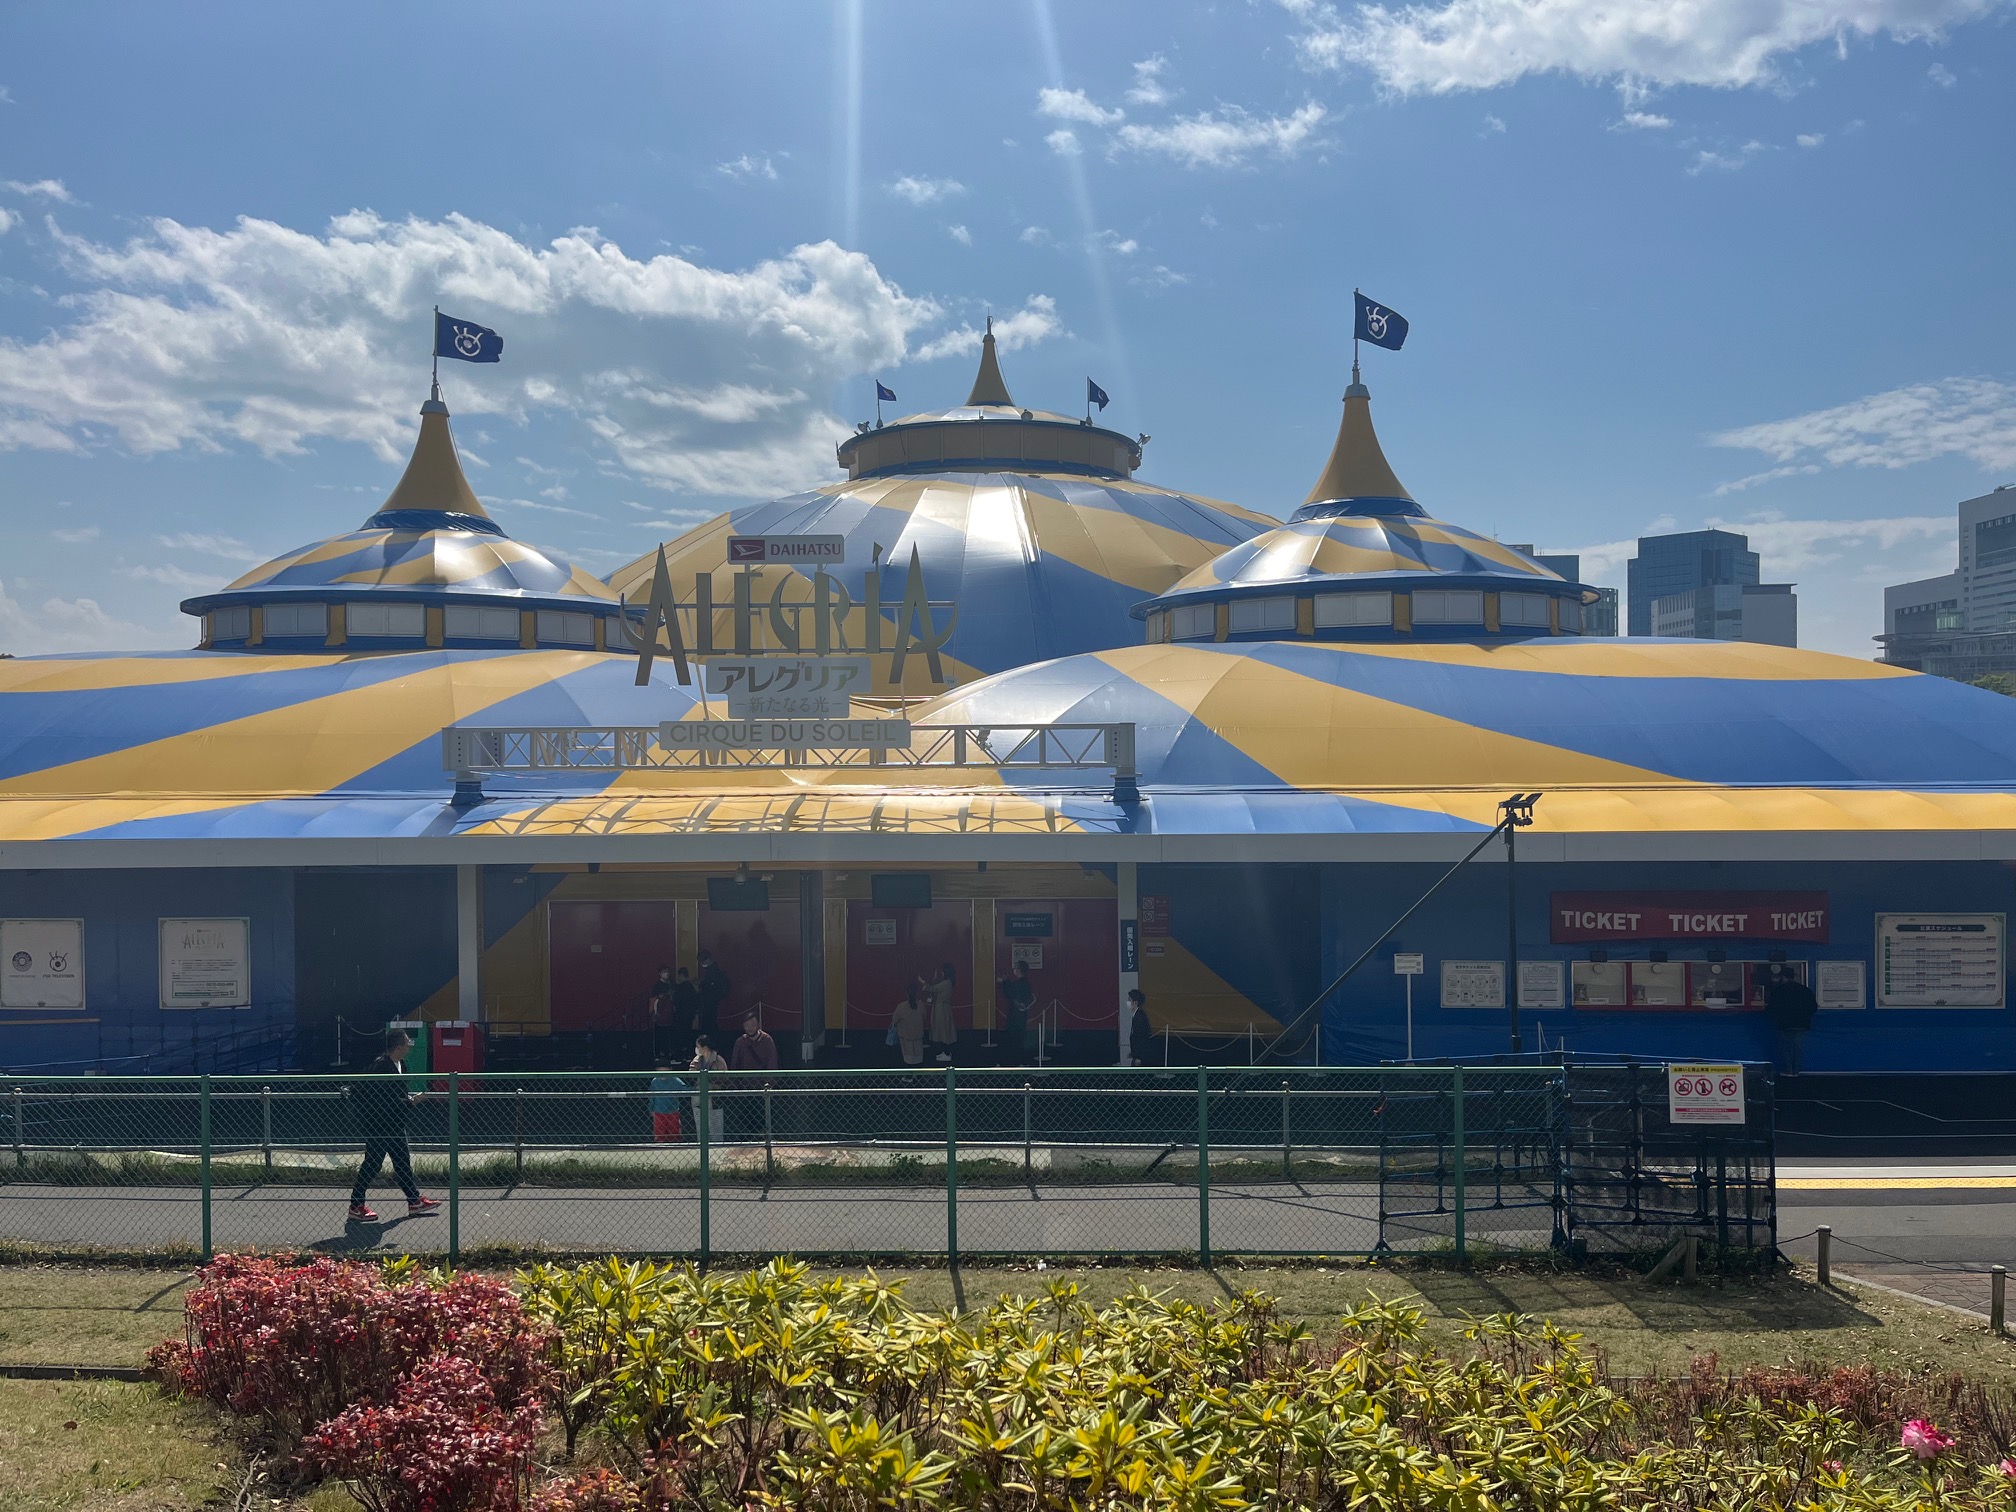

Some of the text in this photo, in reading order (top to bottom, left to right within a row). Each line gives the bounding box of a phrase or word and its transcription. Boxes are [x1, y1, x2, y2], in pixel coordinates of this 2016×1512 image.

[770, 543, 841, 556] DAIHATSU
[717, 660, 860, 693] アレグリア
[670, 722, 897, 748] CIRQUE DU SOLEIL
[1561, 910, 1824, 932] TICKET TICKET TICKET
